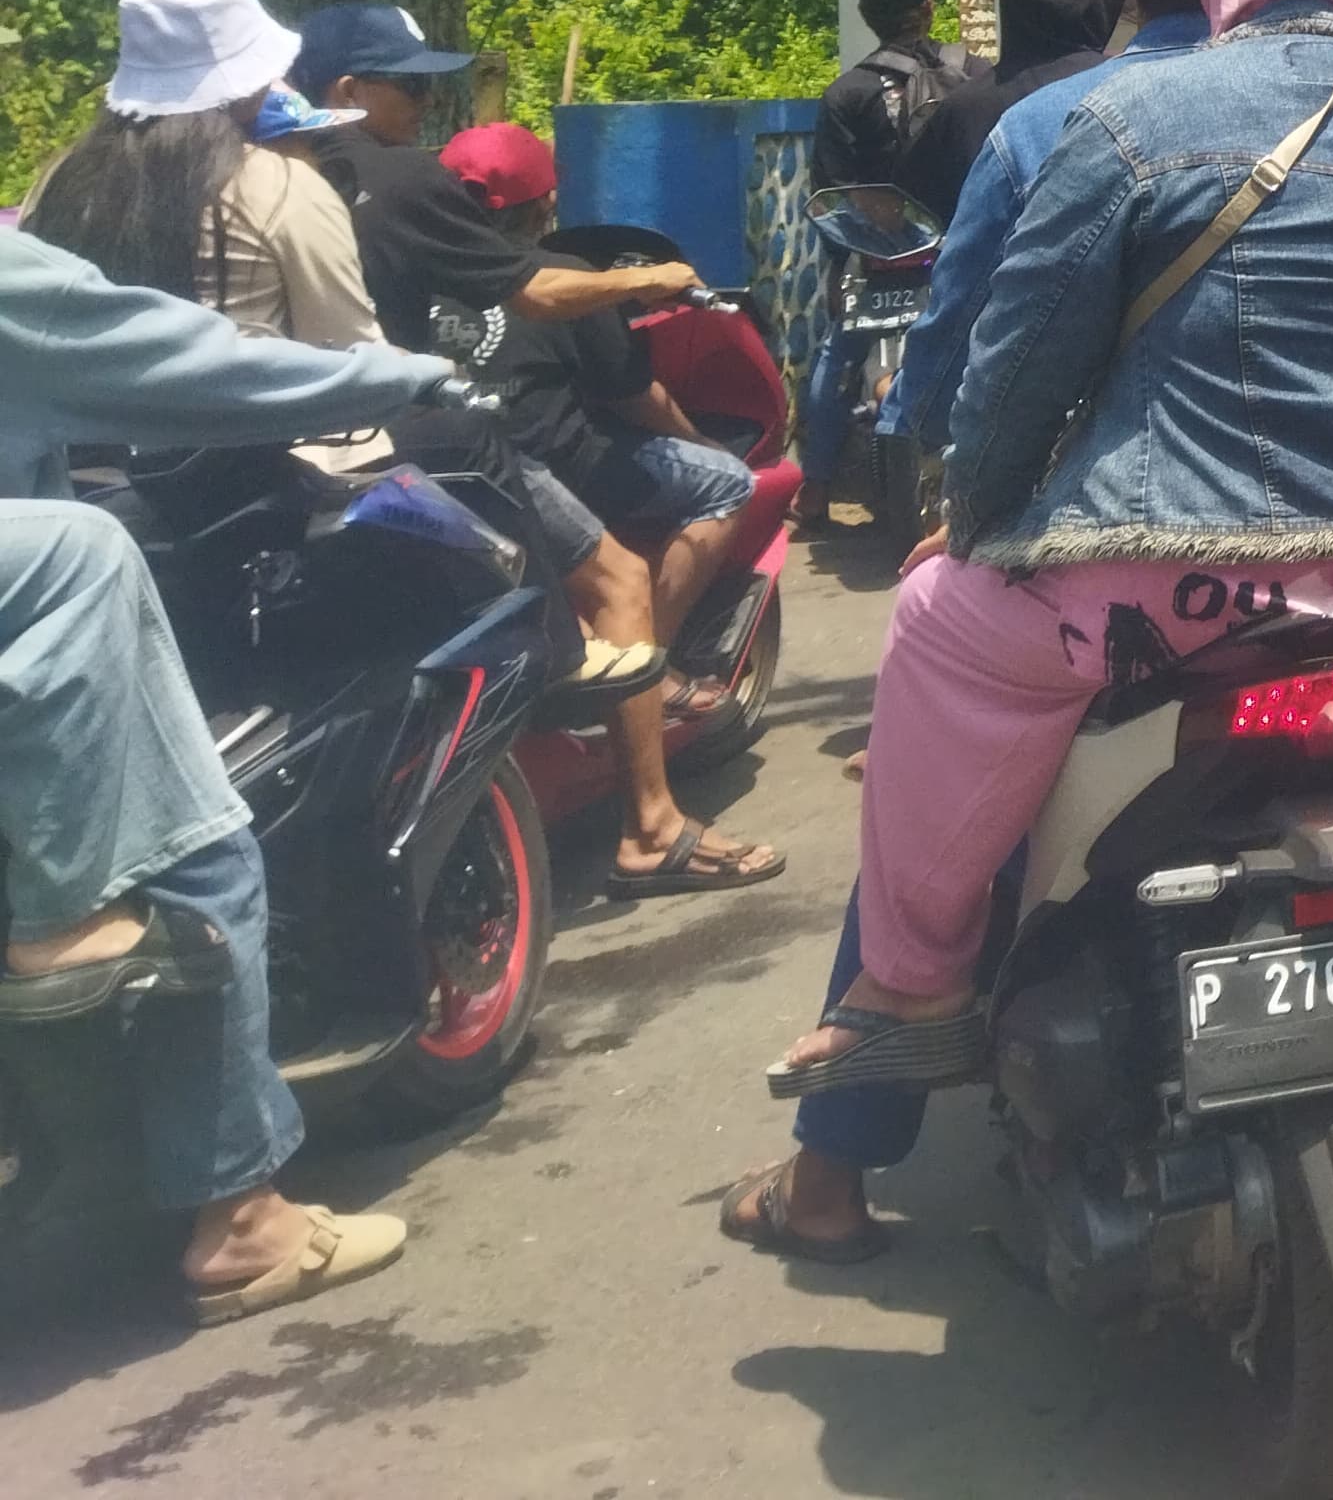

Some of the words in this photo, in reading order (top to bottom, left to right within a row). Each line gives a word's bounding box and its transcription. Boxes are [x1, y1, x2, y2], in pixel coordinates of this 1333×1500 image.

[845, 295, 857, 313] P
[871, 290, 915, 310] 3122
[1194, 973, 1222, 1027] P
